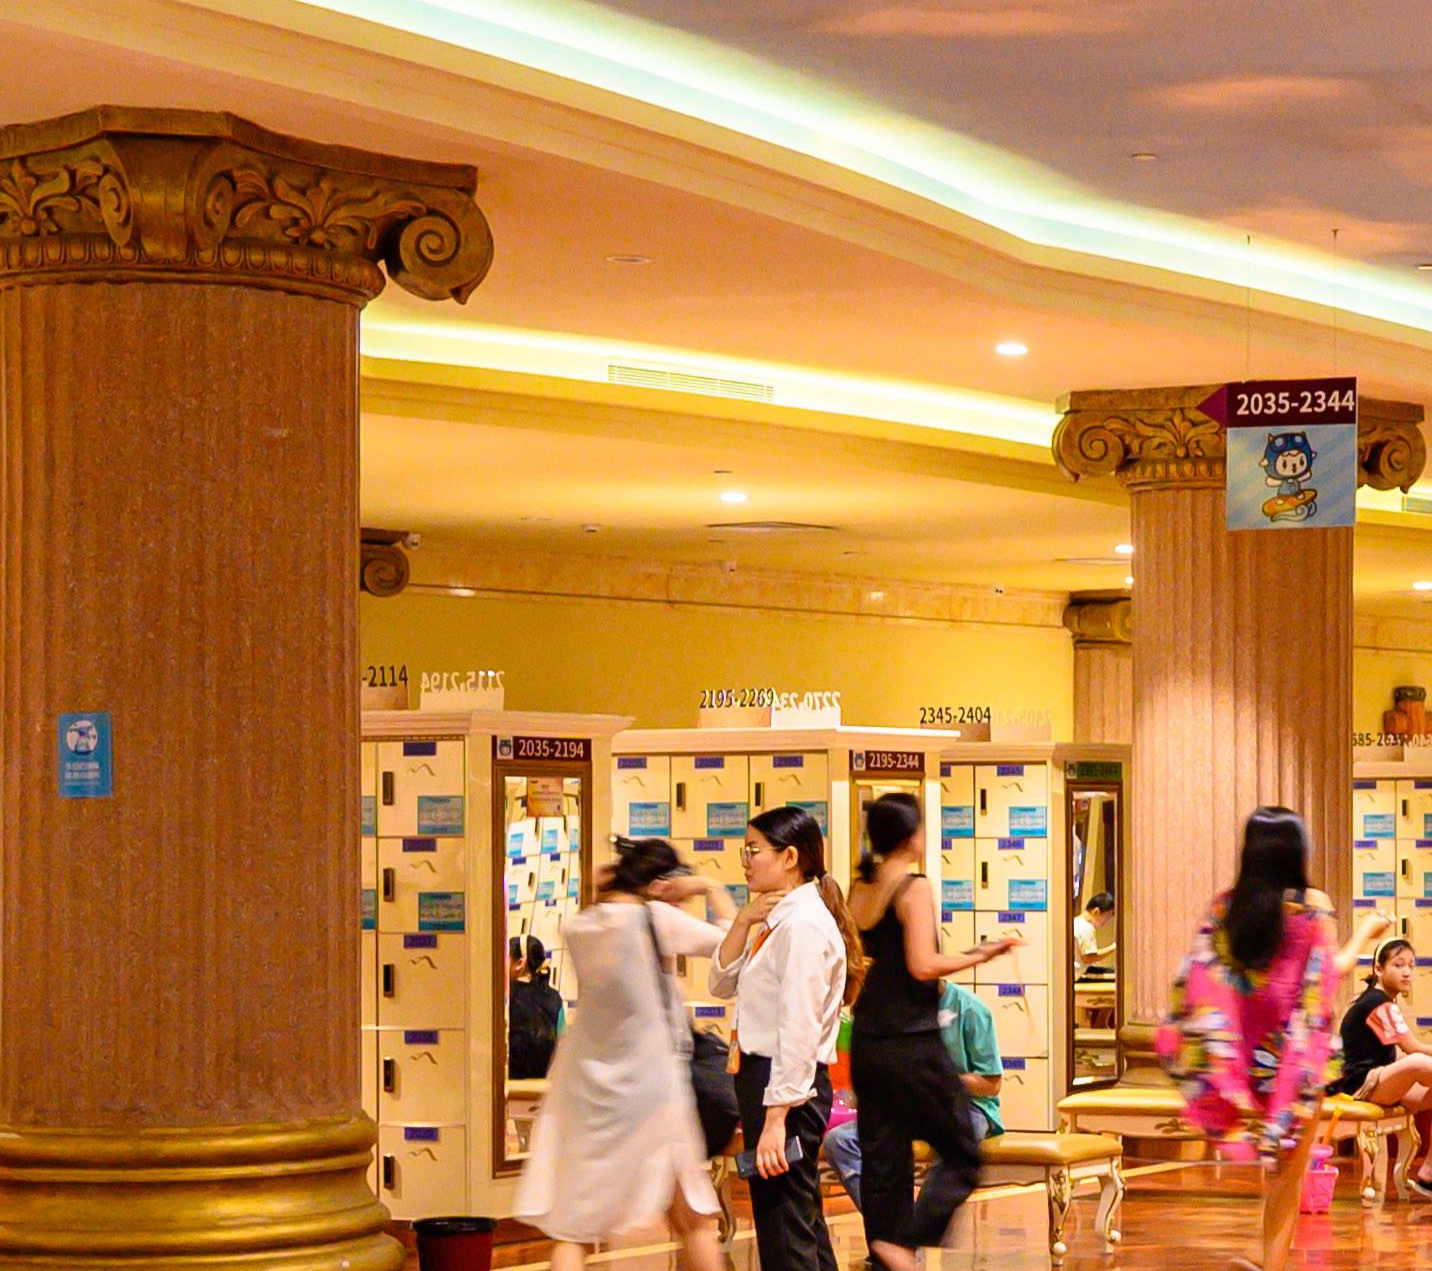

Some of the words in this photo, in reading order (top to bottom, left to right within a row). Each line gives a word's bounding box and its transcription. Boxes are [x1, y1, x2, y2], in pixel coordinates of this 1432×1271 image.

[1236, 389, 1355, 416] 2035-2344
[919, 706, 991, 724] 2345-2404
[518, 738, 585, 758] 2035-2194
[869, 752, 920, 769] 2195-2344
